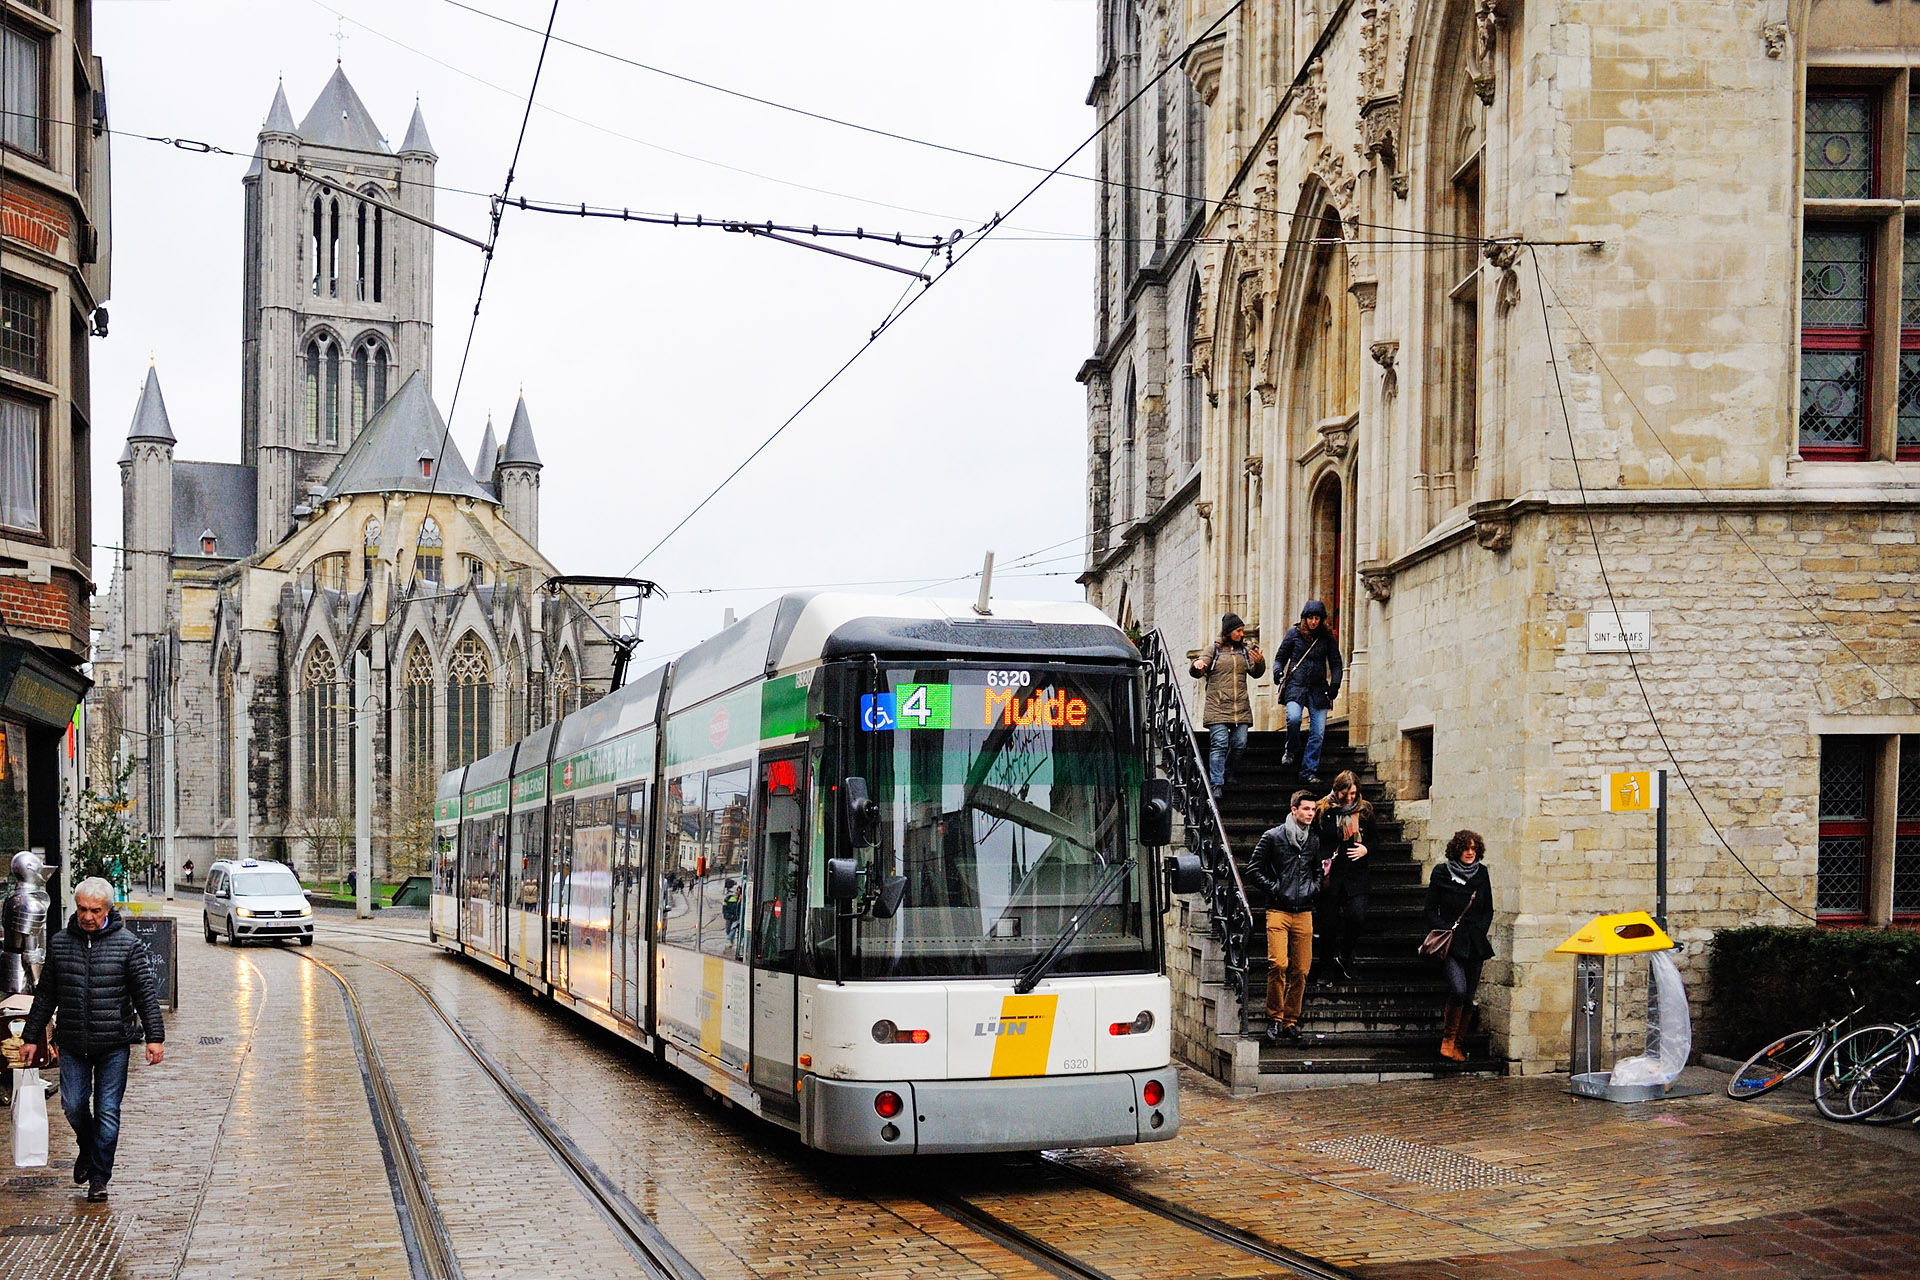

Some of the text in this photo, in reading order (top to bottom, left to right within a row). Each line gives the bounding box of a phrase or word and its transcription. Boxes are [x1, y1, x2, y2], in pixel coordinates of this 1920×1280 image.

[987, 671, 1031, 687] 6320
[902, 686, 932, 726] 4
[984, 687, 1088, 727] Muide
[1063, 1058, 1089, 1070] 6320
